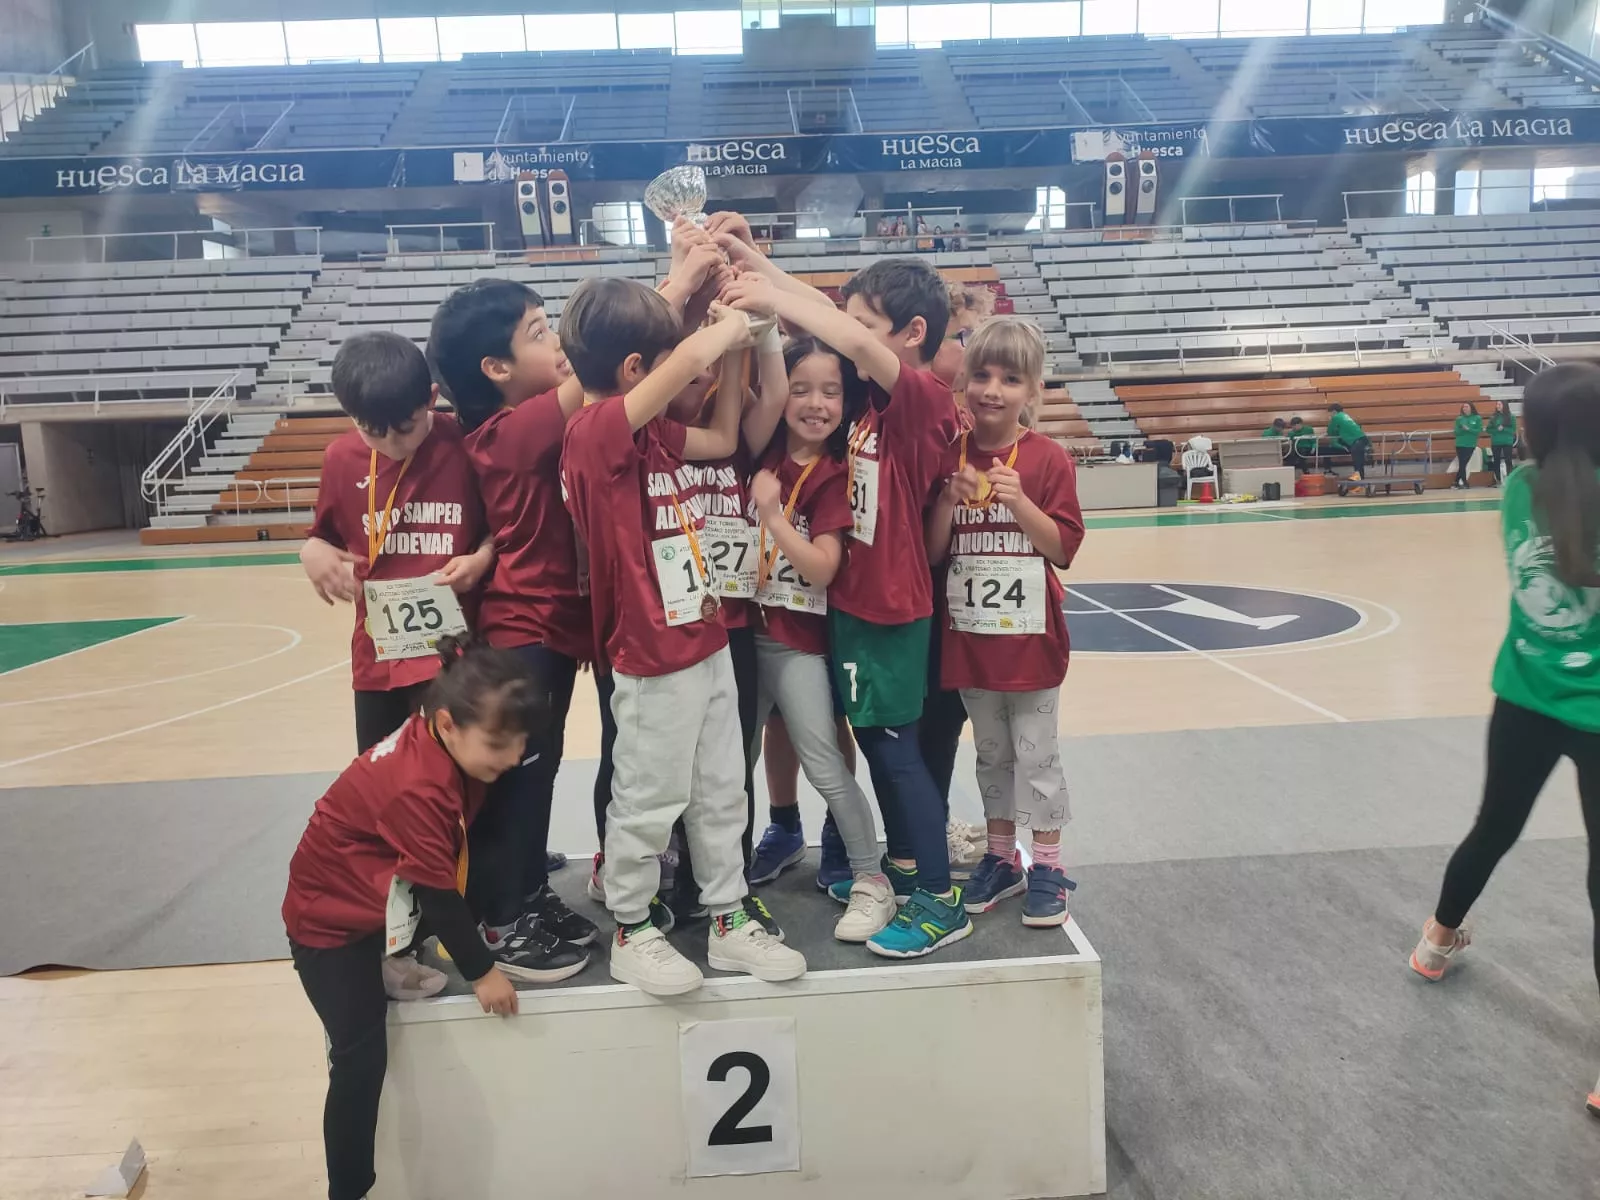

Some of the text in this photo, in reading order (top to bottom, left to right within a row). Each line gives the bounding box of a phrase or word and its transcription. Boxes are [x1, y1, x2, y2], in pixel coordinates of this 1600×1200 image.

[404, 502, 462, 525] SAMPER
[964, 577, 1025, 608] 124
[383, 599, 443, 633] 125
[843, 662, 857, 702] 7
[706, 1051, 772, 1146] 2
